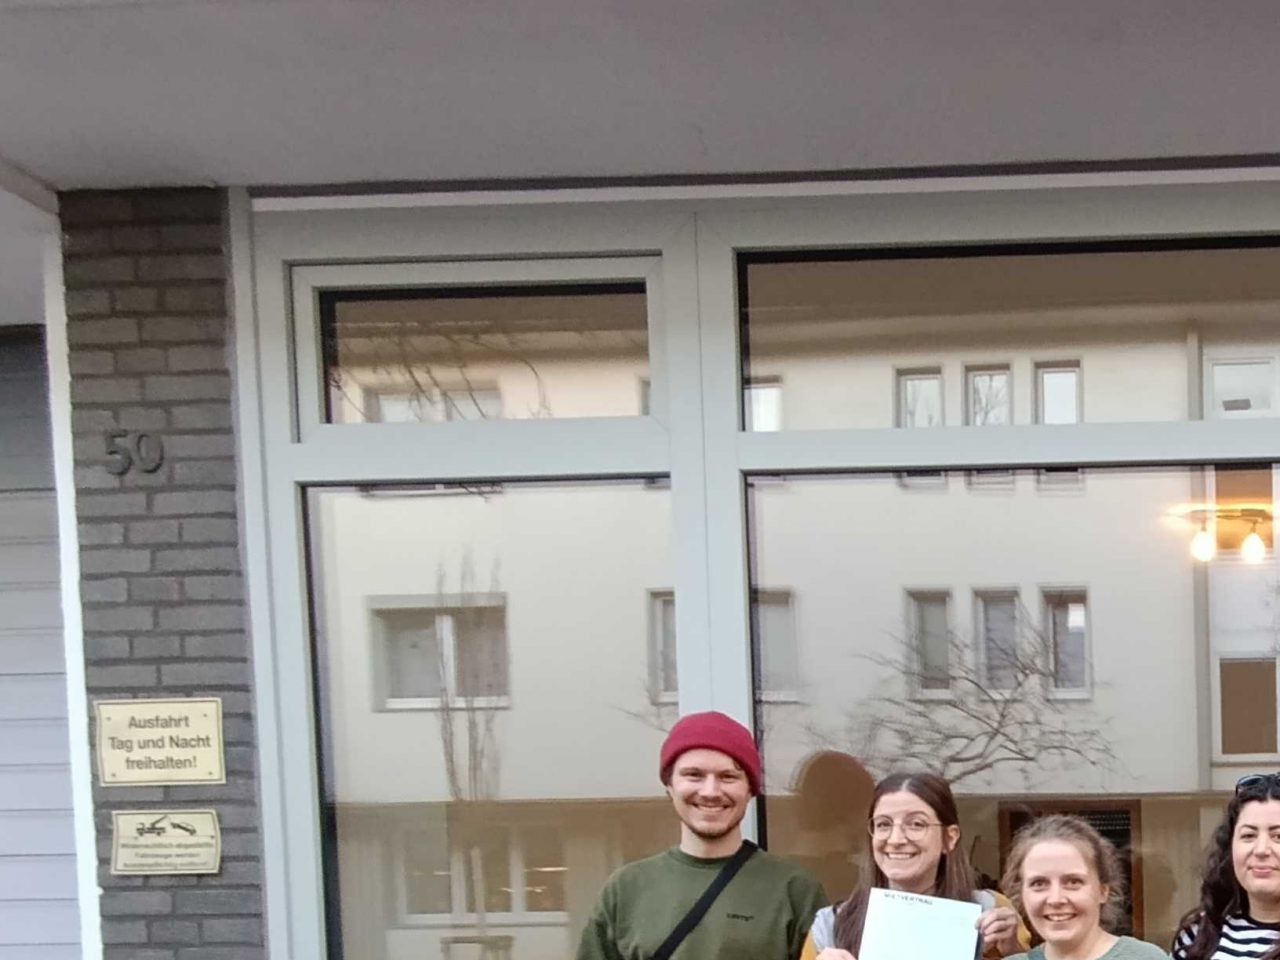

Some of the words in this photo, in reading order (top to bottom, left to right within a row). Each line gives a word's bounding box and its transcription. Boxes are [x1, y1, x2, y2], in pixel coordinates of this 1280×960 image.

[103, 429, 164, 476] 50
[128, 715, 190, 729] Ausfahrt
[108, 737, 133, 752] Tag
[138, 735, 165, 749] und
[169, 735, 212, 749] Nacht
[125, 755, 197, 771] freihalten!
